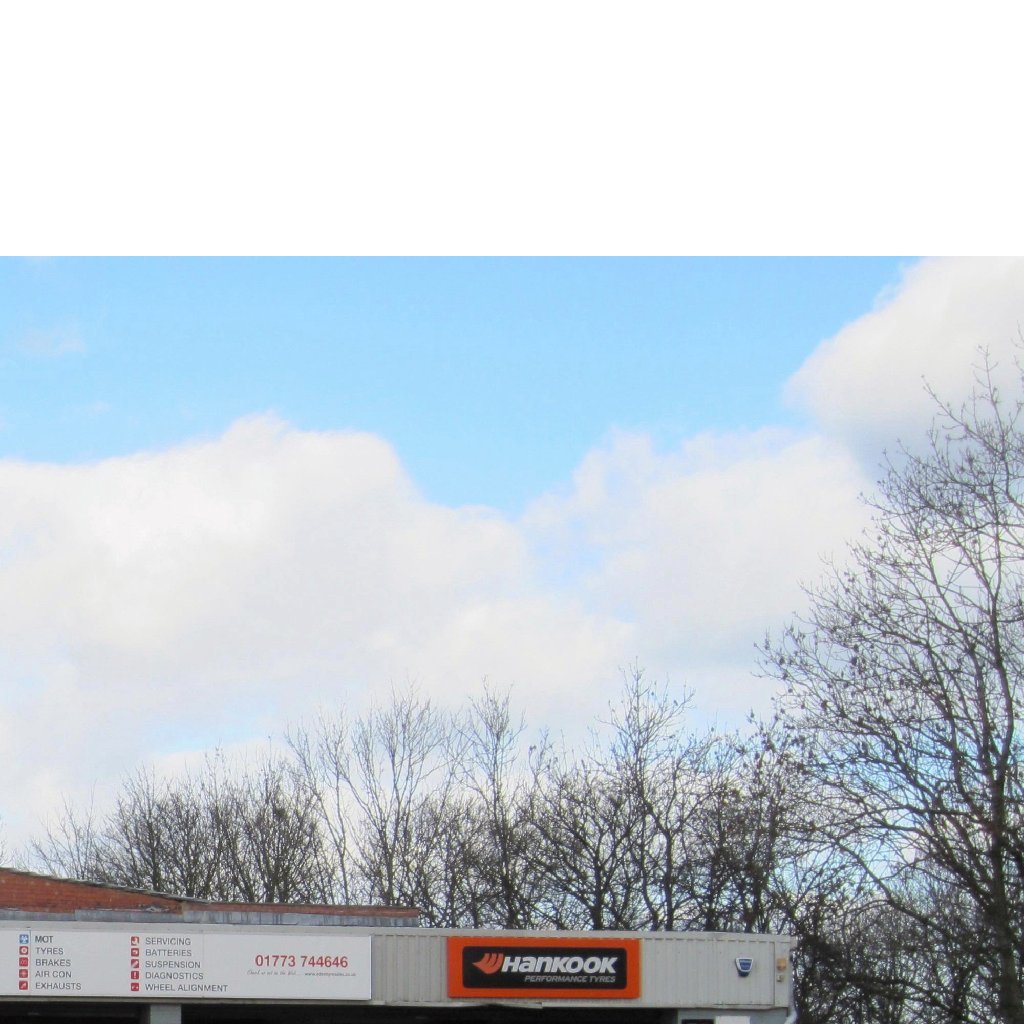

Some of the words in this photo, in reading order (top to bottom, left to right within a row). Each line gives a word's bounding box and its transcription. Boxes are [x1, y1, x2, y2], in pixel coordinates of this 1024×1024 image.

[35, 935, 53, 943] MOT
[145, 937, 191, 946] SERVICING
[36, 947, 64, 955] TYRES
[145, 949, 192, 957] BATTERIES
[36, 959, 71, 967] BRAKES
[145, 961, 201, 969] SUSPENSION
[255, 955, 296, 967] 01773
[300, 956, 348, 968] 744646
[145, 972, 204, 980] DIAGNOSTICS
[589, 975, 616, 983] TYRES
[35, 982, 82, 990] EXHAUSTS
[177, 984, 228, 992] ALIGNMENT
